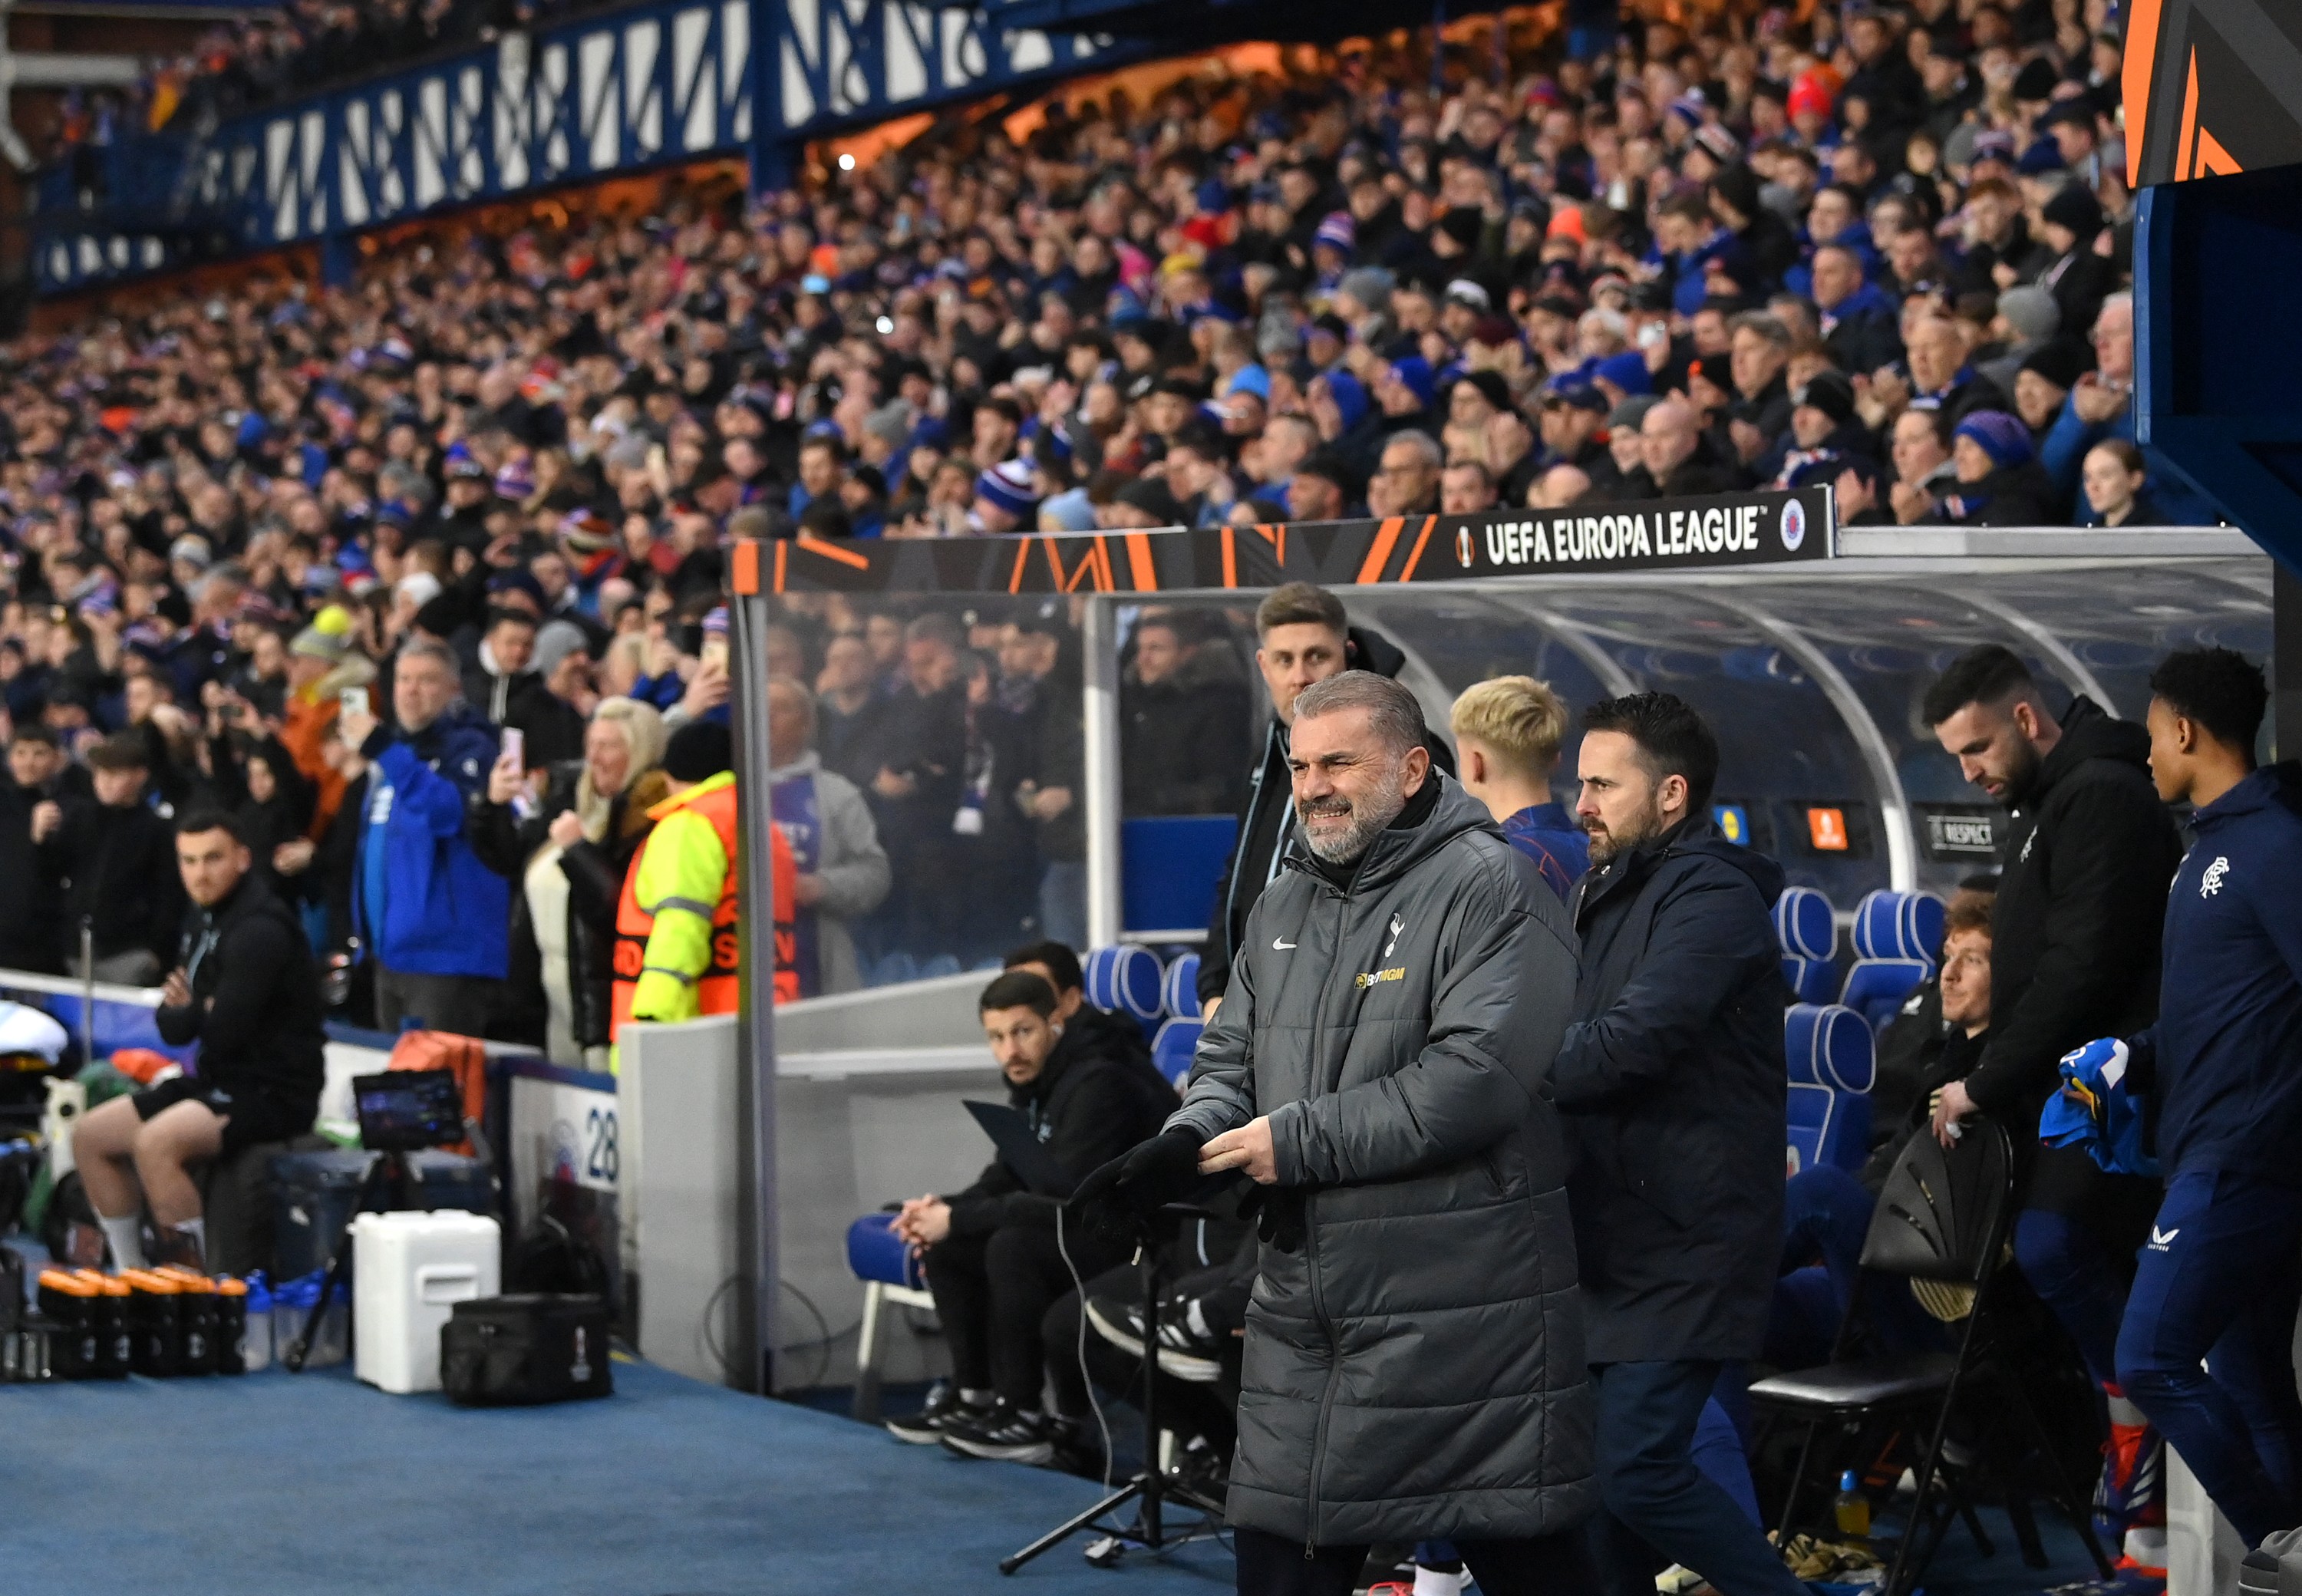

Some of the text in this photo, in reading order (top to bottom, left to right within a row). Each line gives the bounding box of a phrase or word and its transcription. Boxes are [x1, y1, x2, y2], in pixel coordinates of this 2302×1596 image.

[1486, 521, 1552, 566] UEFA
[1553, 515, 1651, 562] EUROPA
[1367, 967, 1406, 987] BTMGM
[586, 1107, 619, 1182] 28
